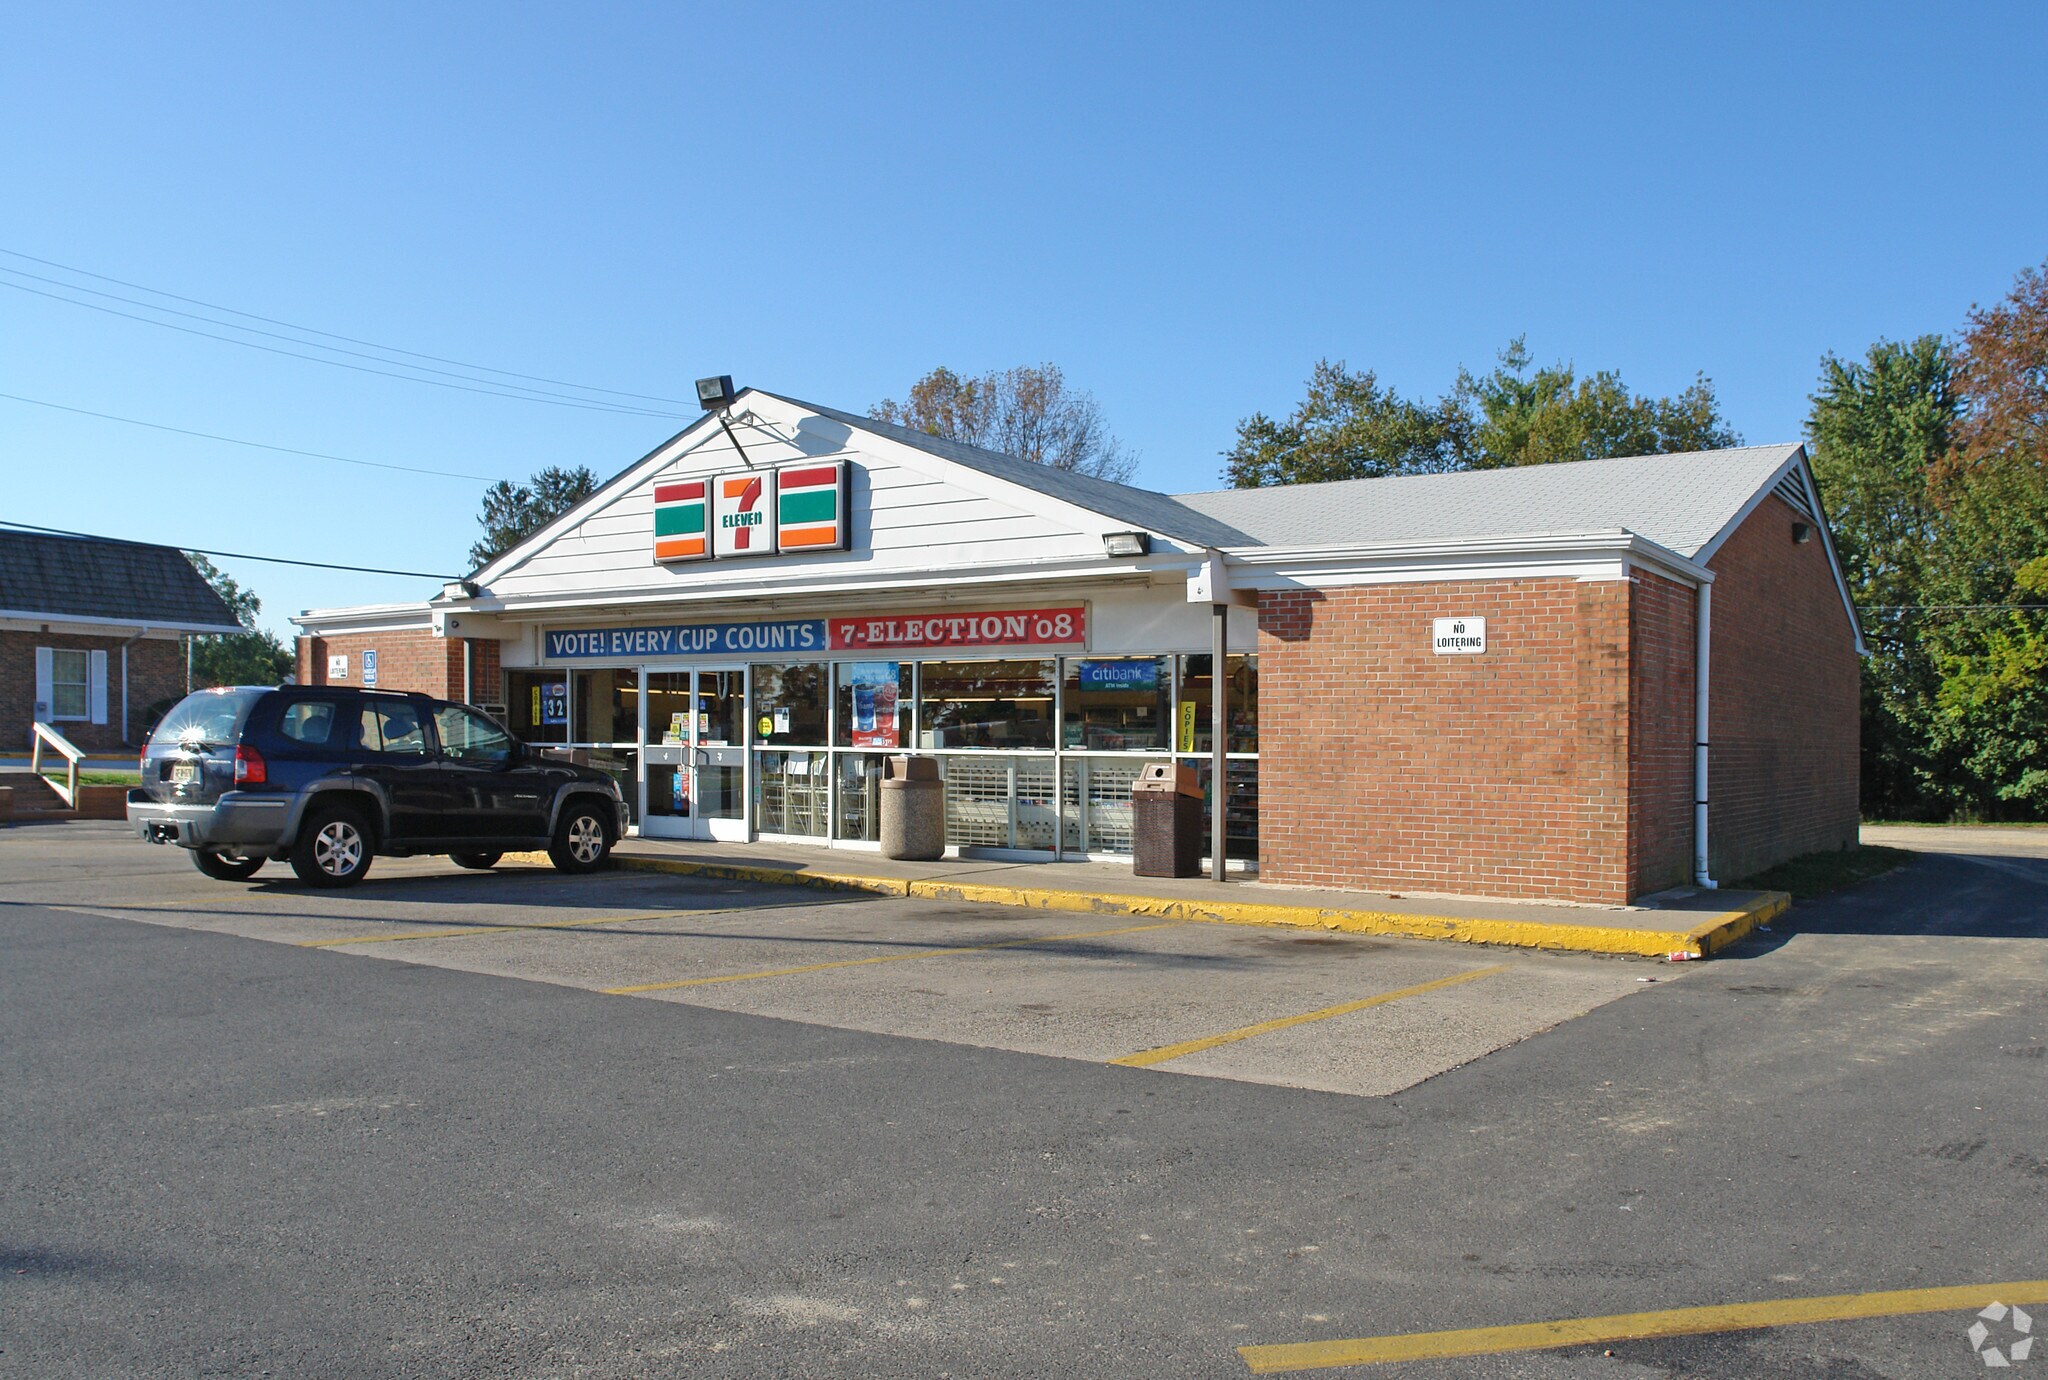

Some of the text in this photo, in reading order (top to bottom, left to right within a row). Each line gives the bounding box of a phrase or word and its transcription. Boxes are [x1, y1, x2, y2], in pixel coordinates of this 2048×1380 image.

[723, 476, 762, 549] 7
[553, 624, 815, 654] VOTE! EVERY CUP COUNTS
[841, 615, 1028, 643] 7-ELECTION
[1437, 637, 1482, 647] LOITERING
[1453, 624, 1465, 634] NO
[1092, 666, 1142, 680] citibank
[1184, 706, 1192, 750] COPIES
